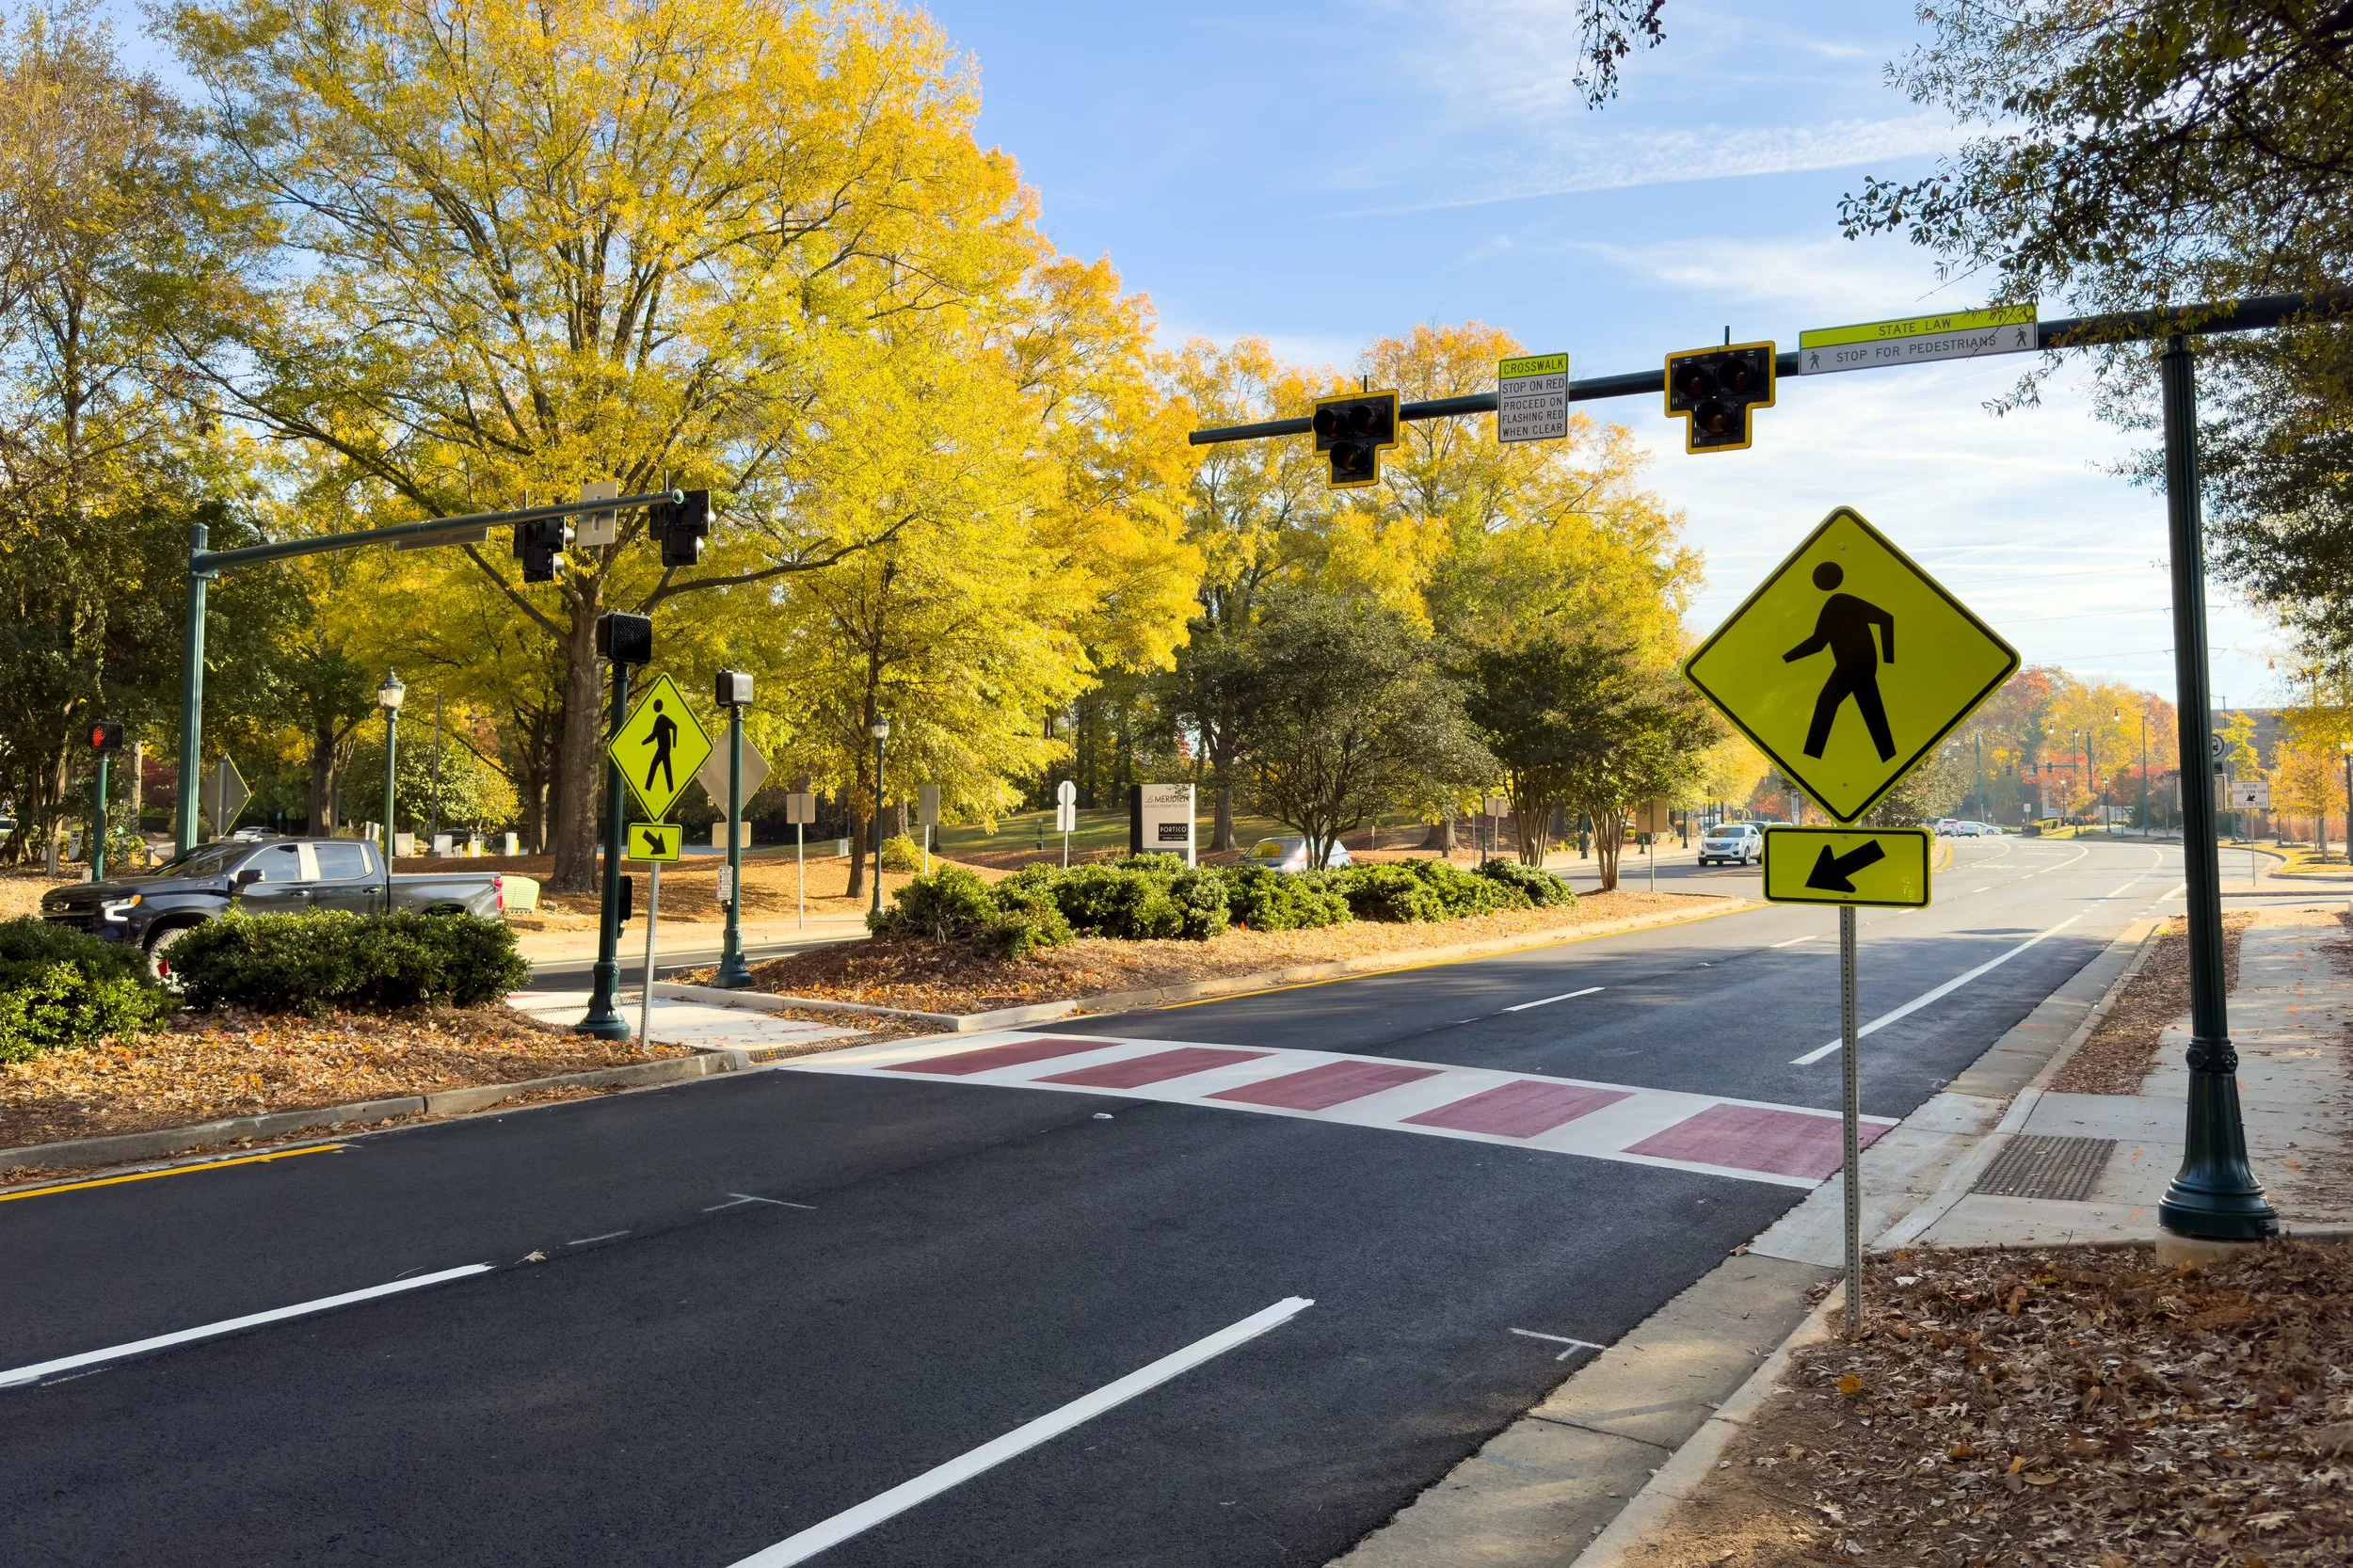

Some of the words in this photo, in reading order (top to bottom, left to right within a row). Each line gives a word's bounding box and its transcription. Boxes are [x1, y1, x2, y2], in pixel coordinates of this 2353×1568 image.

[1879, 322, 1916, 336] STATE
[1925, 318, 1951, 331] LAW
[1836, 350, 1867, 363] STOP
[1876, 345, 1900, 359] FOR
[1909, 335, 1997, 356] PEDESTRIANS
[1503, 358, 1564, 375] CROSSWALK
[1502, 381, 1526, 394] STOP
[1529, 379, 1543, 391] ON
[1545, 377, 1565, 390] RED
[1503, 398, 1545, 411] PROCEED
[1549, 396, 1562, 407] ON
[1502, 411, 1544, 424] FLASHING
[1546, 409, 1563, 420] RED
[1502, 426, 1529, 437] WHEN
[1532, 423, 1562, 434] CLEAR
